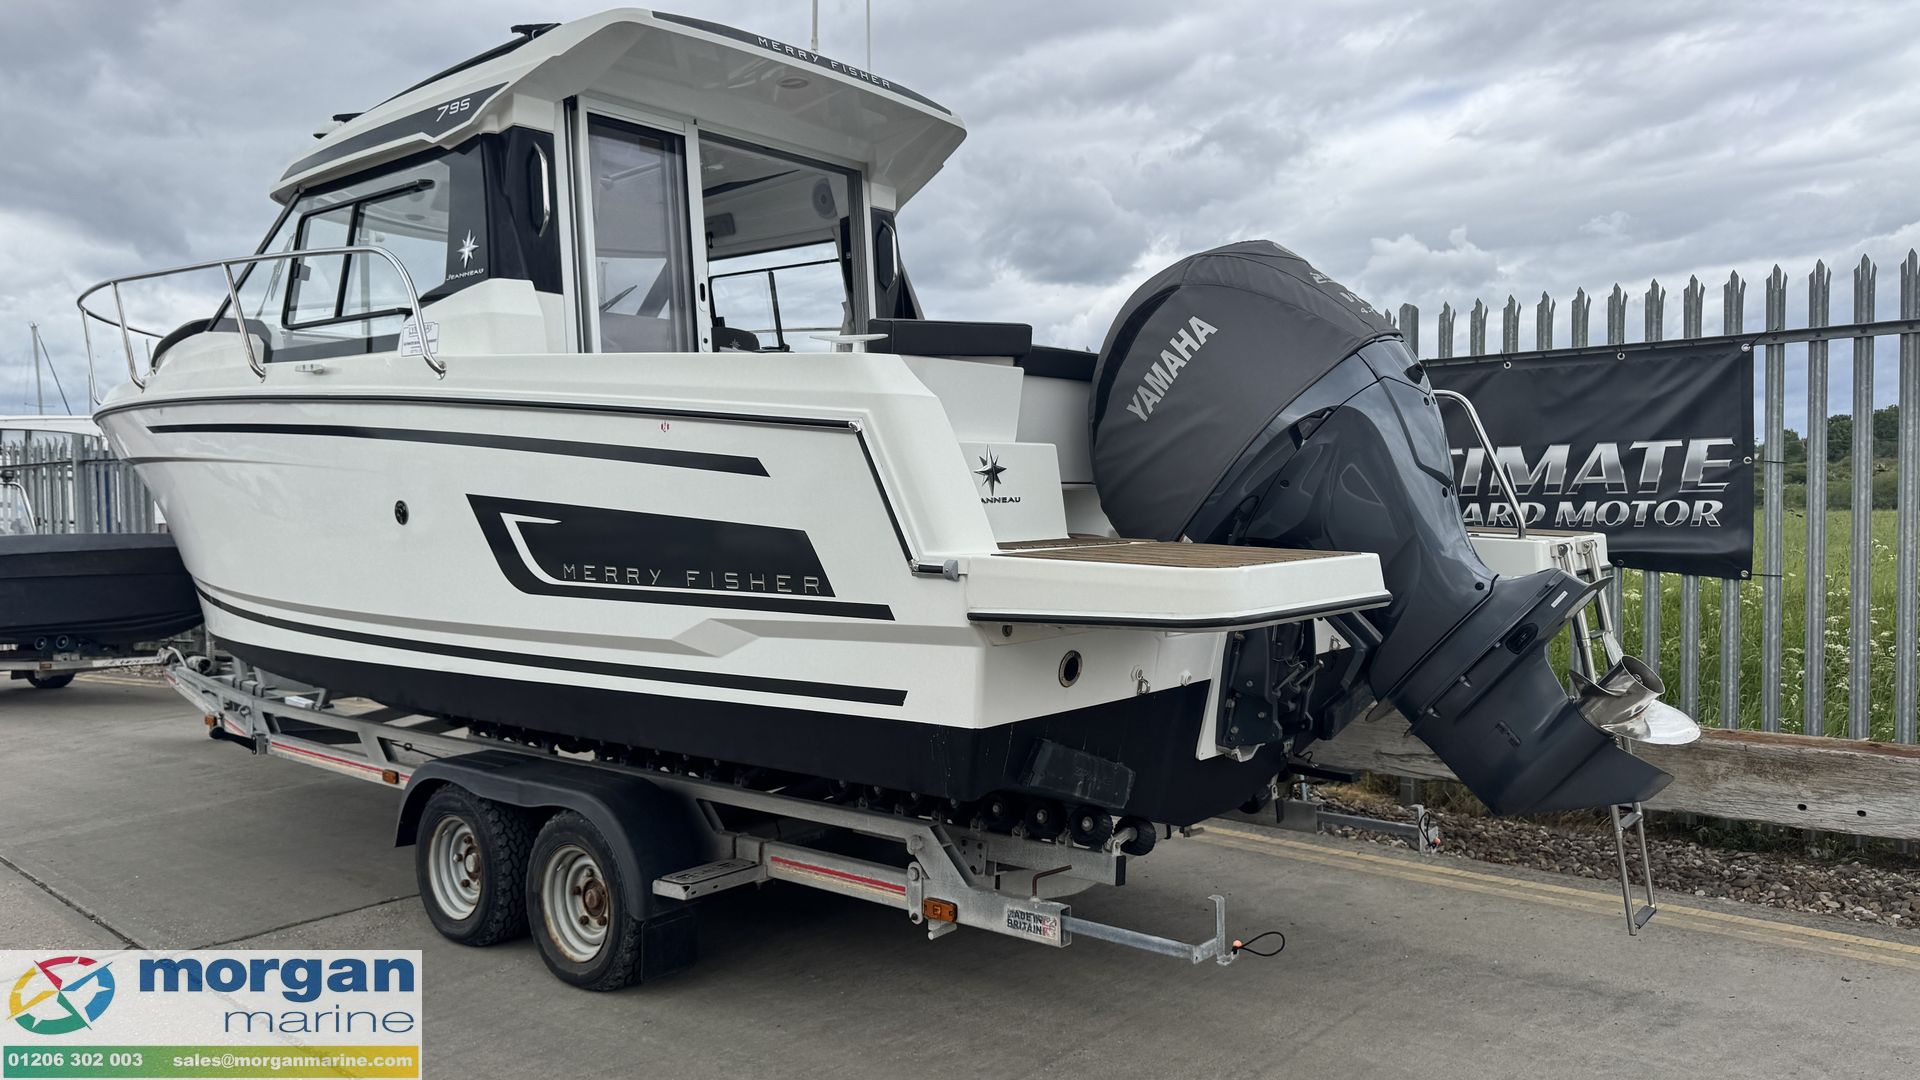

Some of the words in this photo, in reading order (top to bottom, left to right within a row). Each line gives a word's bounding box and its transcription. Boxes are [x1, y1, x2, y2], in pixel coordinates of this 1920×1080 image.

[757, 36, 819, 62] MERRY
[830, 61, 891, 88] FISHER
[436, 97, 471, 122] 795
[446, 267, 484, 281] JEANNEAU
[1126, 315, 1219, 422] YAMAHA
[1554, 500, 1724, 527] MOTOR
[563, 563, 661, 585] MERRY
[686, 570, 820, 594] FISHER
[1007, 918, 1042, 935] BRITAIN
